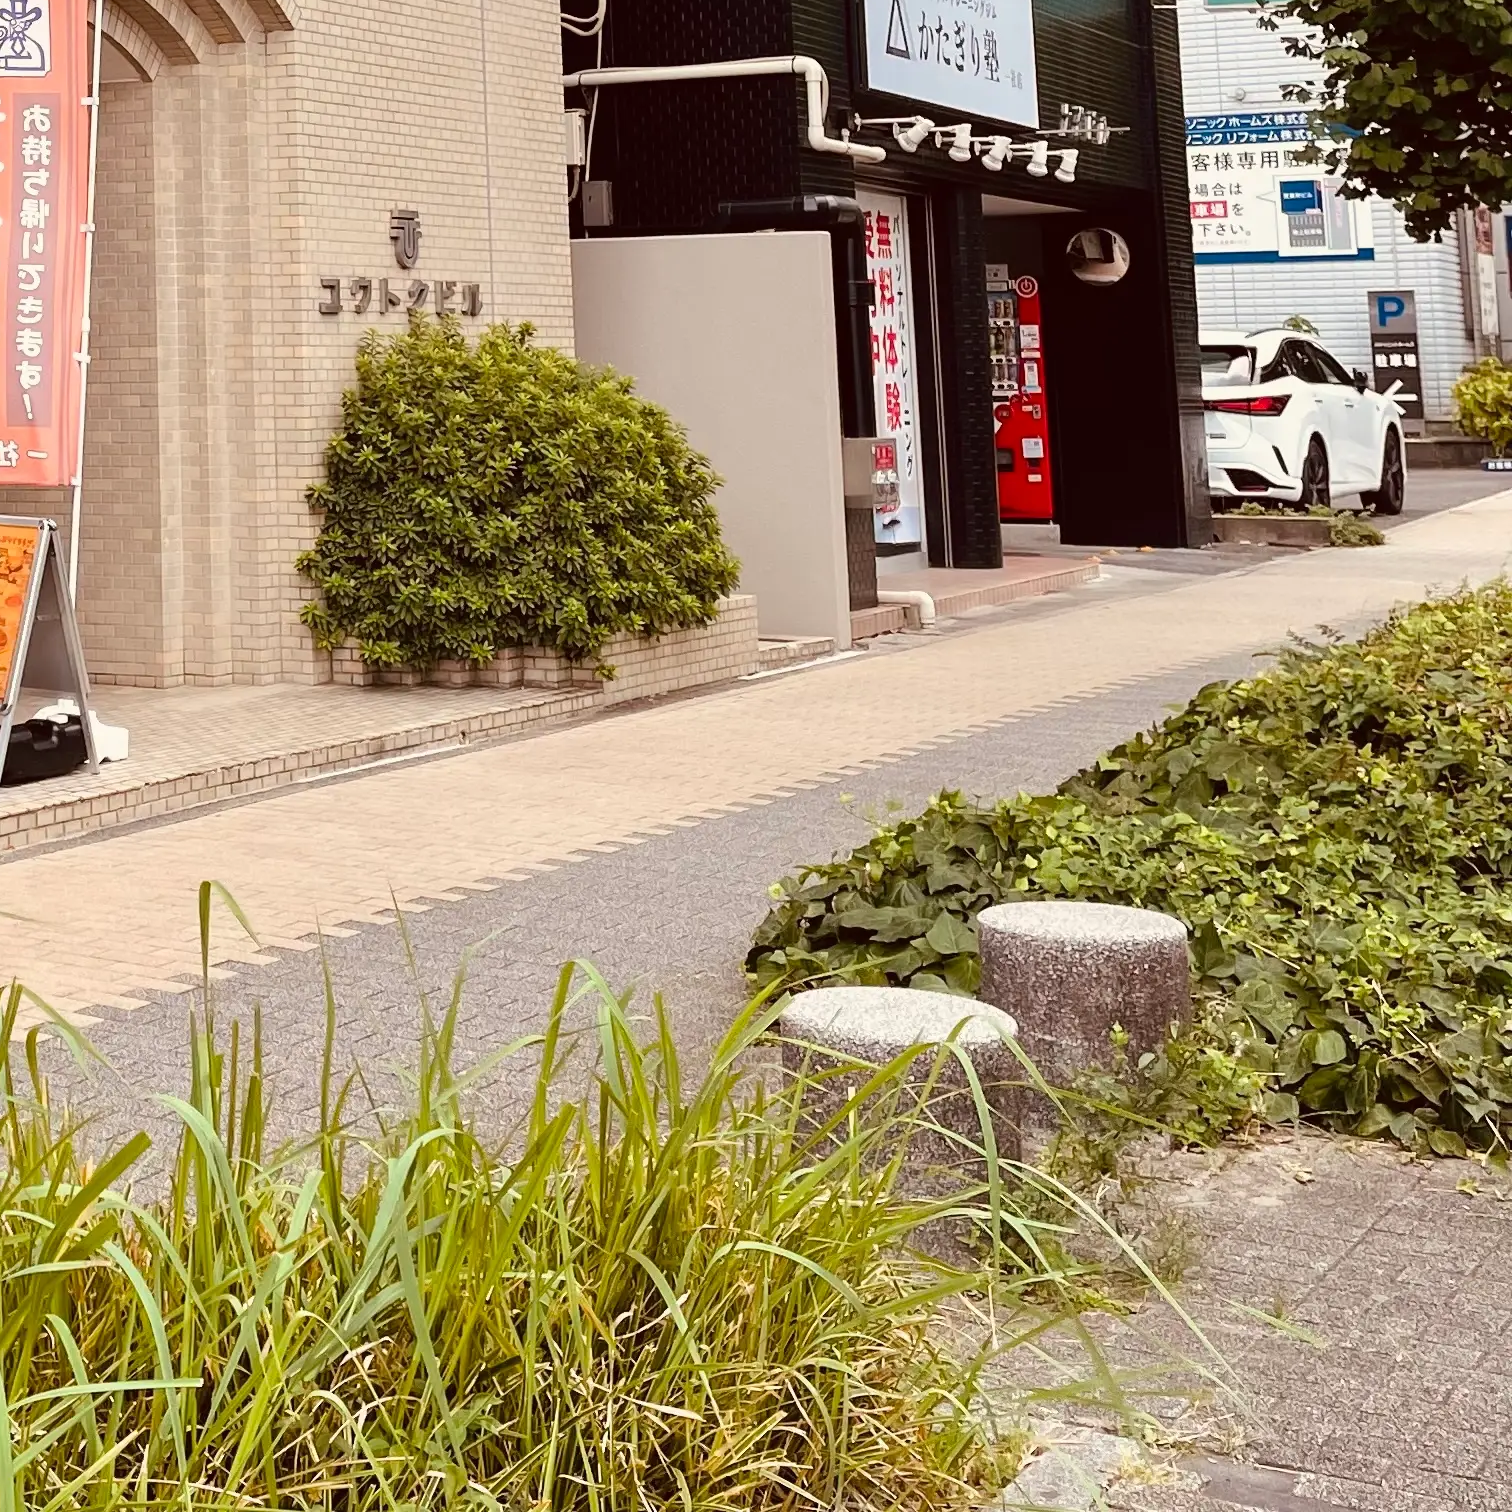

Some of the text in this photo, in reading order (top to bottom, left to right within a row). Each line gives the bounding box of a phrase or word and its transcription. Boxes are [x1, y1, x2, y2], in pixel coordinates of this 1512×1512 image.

[917, 10, 1000, 82] かたぎり塾
[1185, 117, 1227, 130] ソニック
[1228, 115, 1272, 128] ホームズ
[1226, 130, 1279, 144] リフォーム
[1188, 182, 1243, 198] 場合は
[1190, 202, 1226, 219] 車場
[319, 277, 483, 317] コウトクビル
[876, 209, 902, 432] 無料体験
[1377, 296, 1404, 327] P
